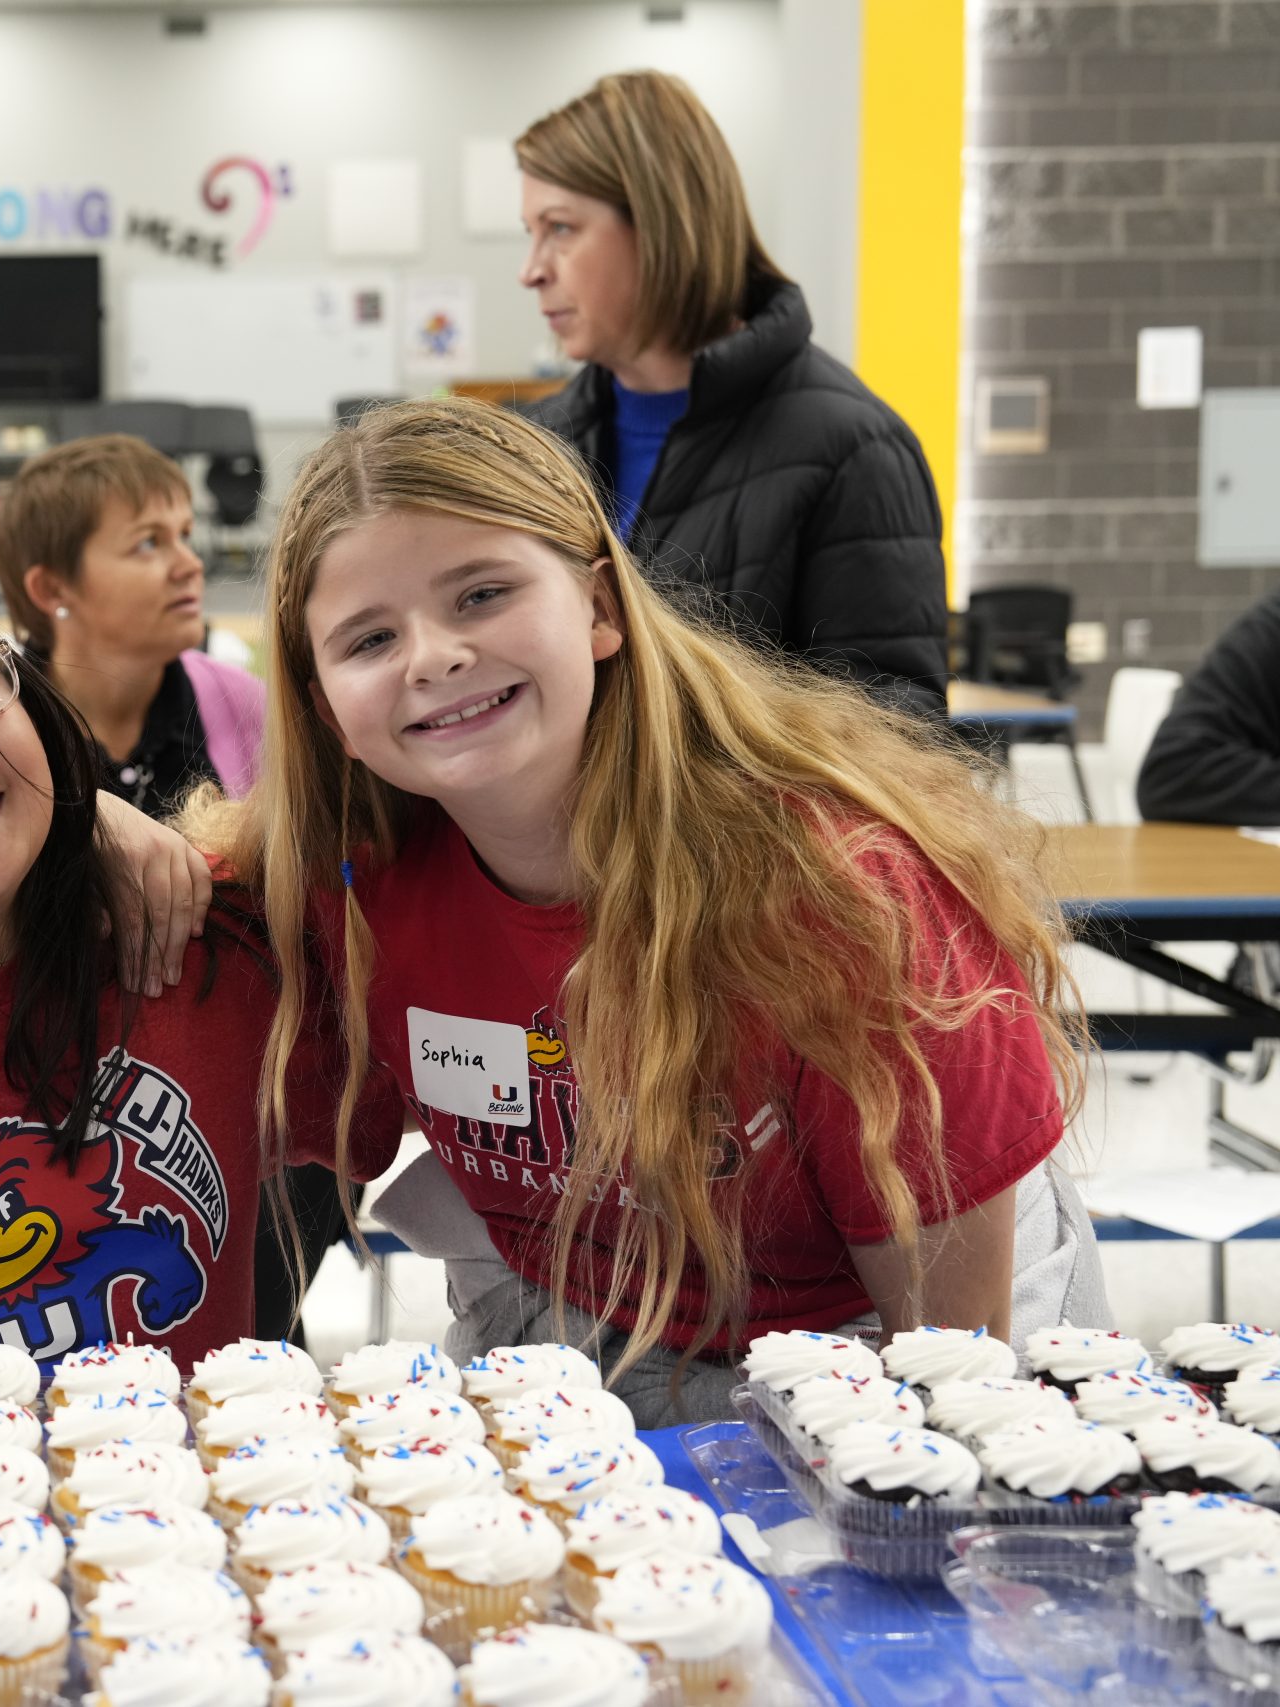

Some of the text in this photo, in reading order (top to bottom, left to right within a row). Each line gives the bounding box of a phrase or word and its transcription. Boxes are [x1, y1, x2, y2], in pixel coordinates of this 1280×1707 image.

[128, 212, 231, 268] HERE
[420, 1040, 487, 1072] Sophia
[492, 1084, 518, 1102] U
[487, 1102, 525, 1113] BELONG
